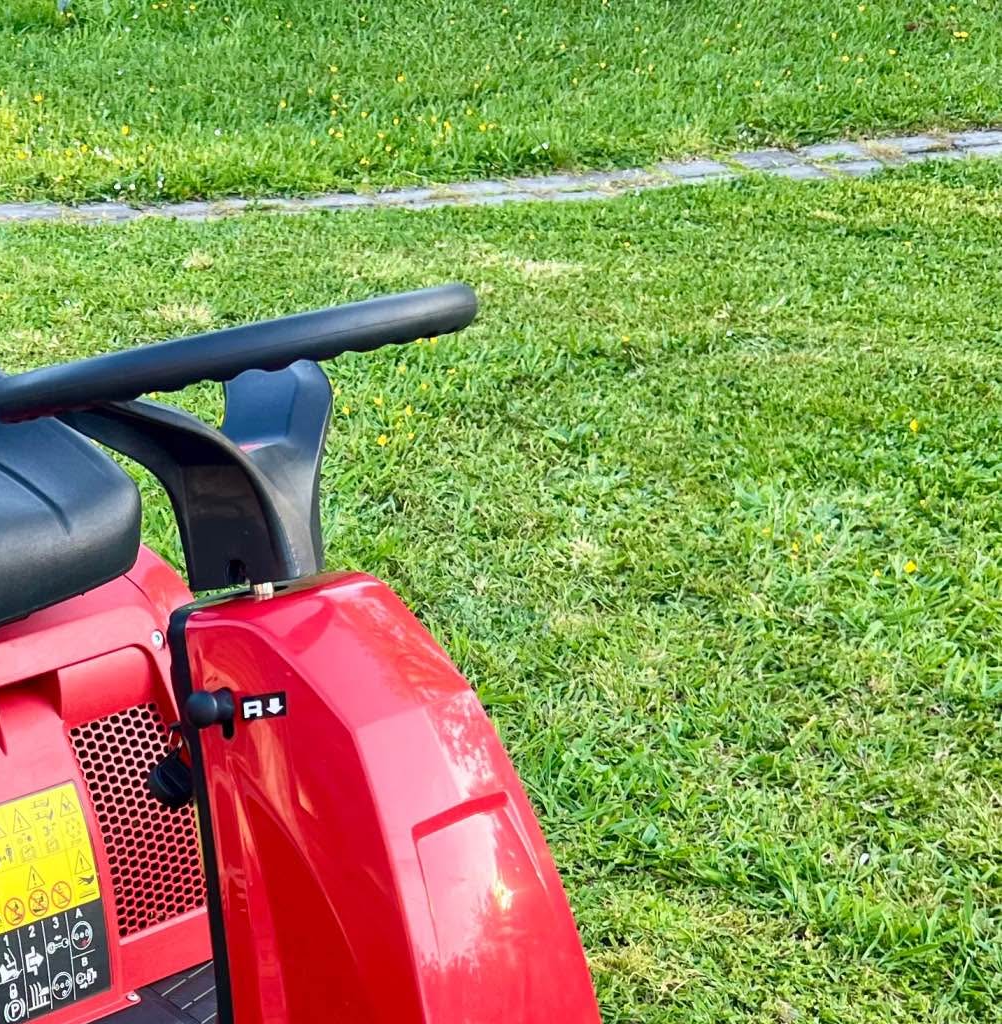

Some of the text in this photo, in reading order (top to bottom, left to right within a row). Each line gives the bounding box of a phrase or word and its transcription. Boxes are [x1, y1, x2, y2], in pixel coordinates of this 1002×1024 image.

[3, 908, 84, 947] 1 2 3 A
[81, 956, 88, 967] B
